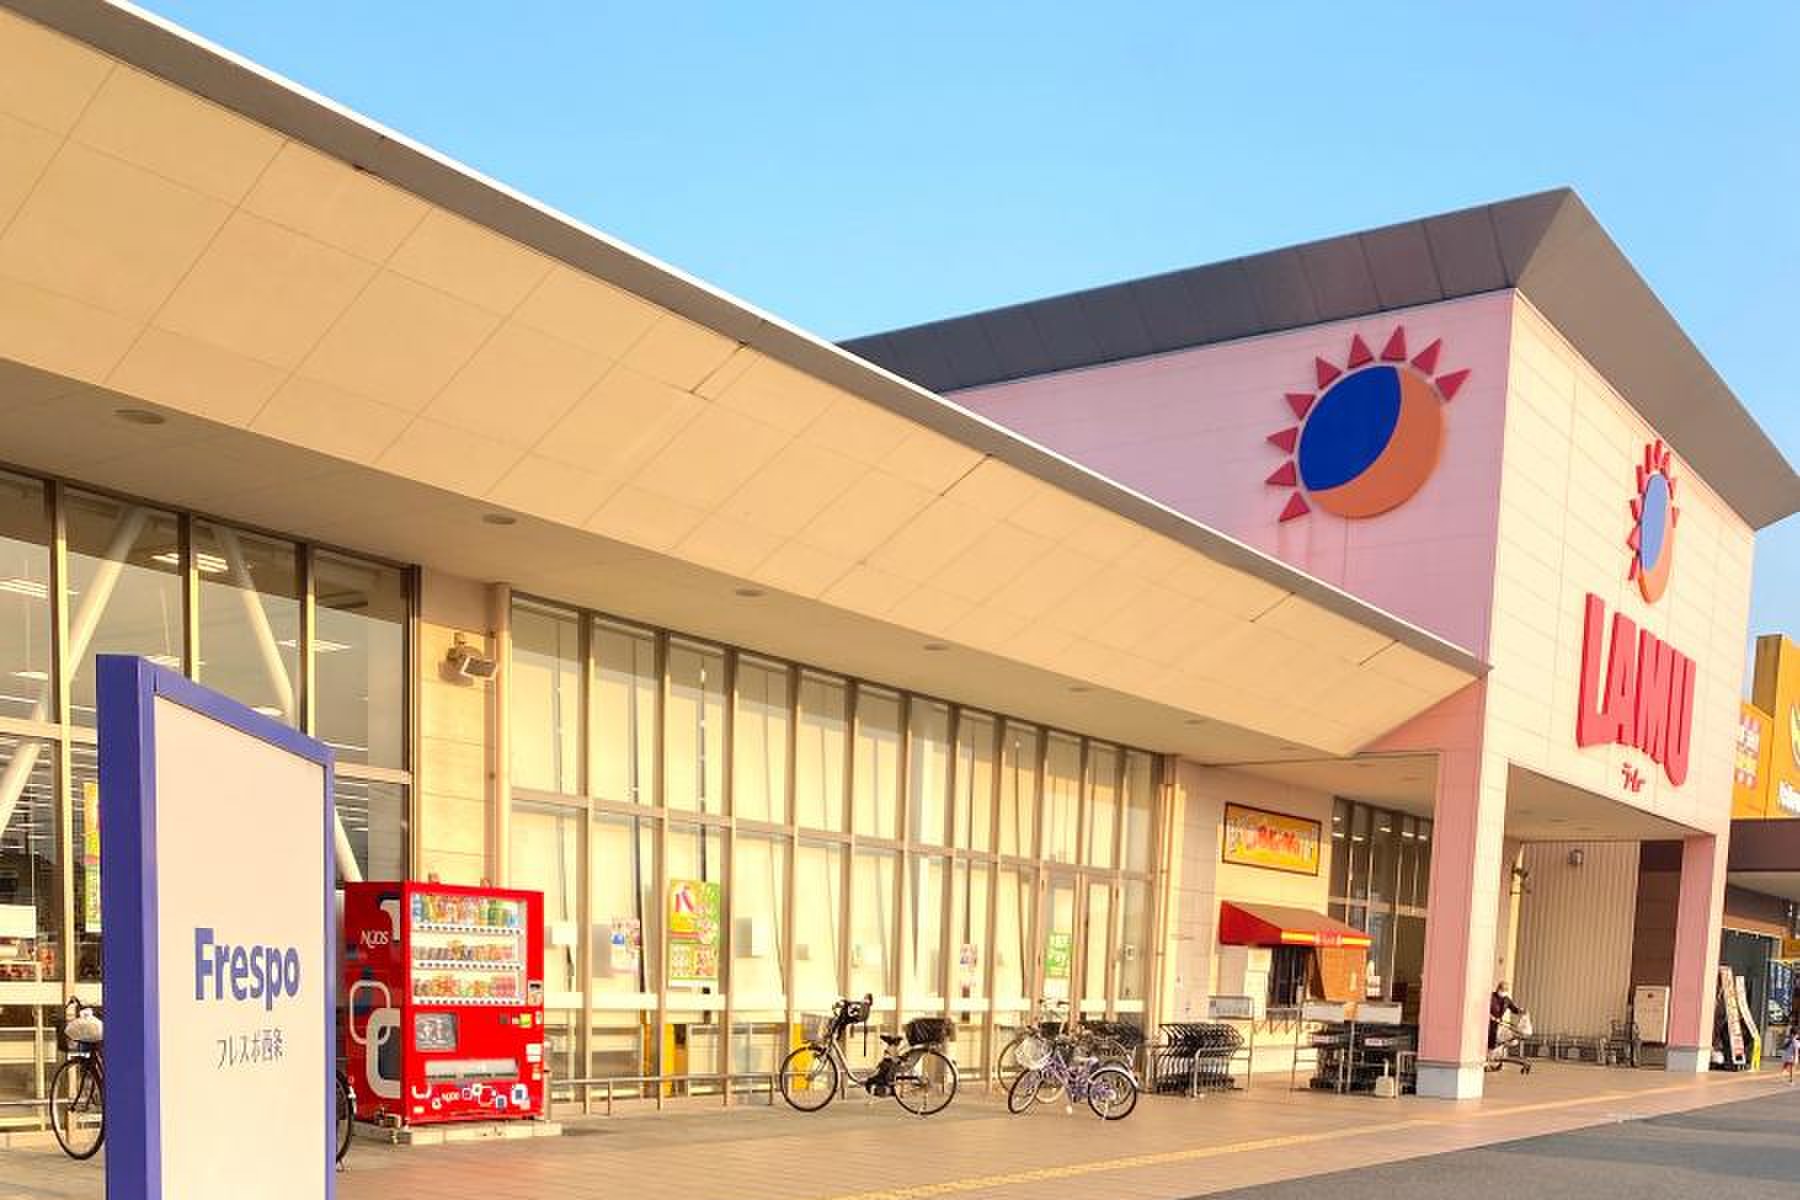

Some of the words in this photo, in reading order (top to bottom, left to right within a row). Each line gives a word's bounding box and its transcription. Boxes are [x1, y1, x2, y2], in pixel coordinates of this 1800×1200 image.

[1576, 592, 1697, 788] LAMU
[194, 927, 300, 1011] Frespo
[216, 1028, 284, 1070] フレスポ西条
